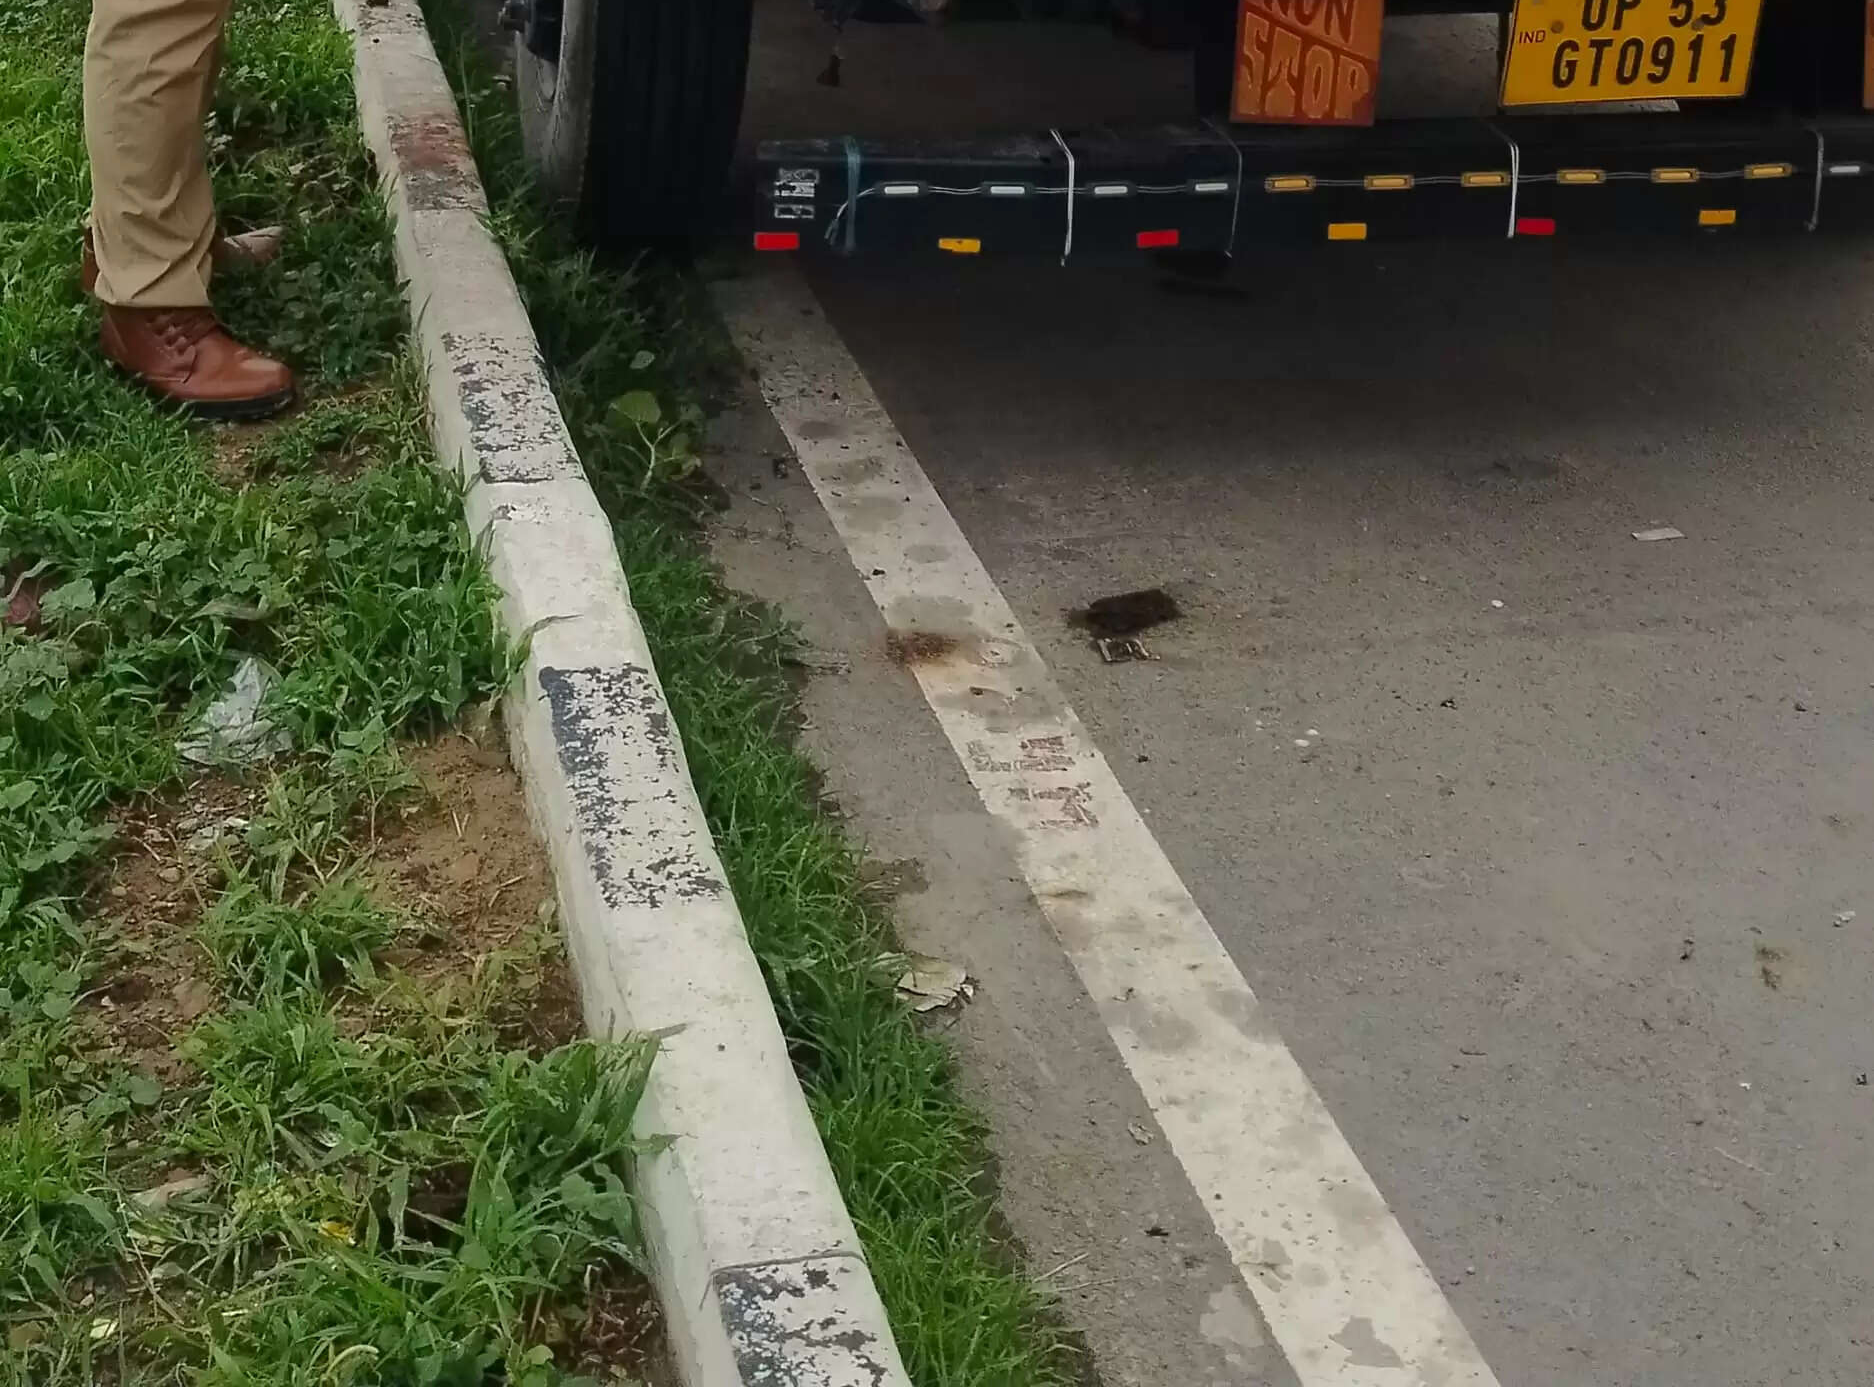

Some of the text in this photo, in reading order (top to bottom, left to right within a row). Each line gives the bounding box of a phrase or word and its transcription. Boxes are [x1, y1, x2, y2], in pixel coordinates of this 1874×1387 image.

[1238, 11, 1371, 119] STOP
[1518, 30, 1546, 44] IND
[1552, 33, 1737, 89] GT0911
